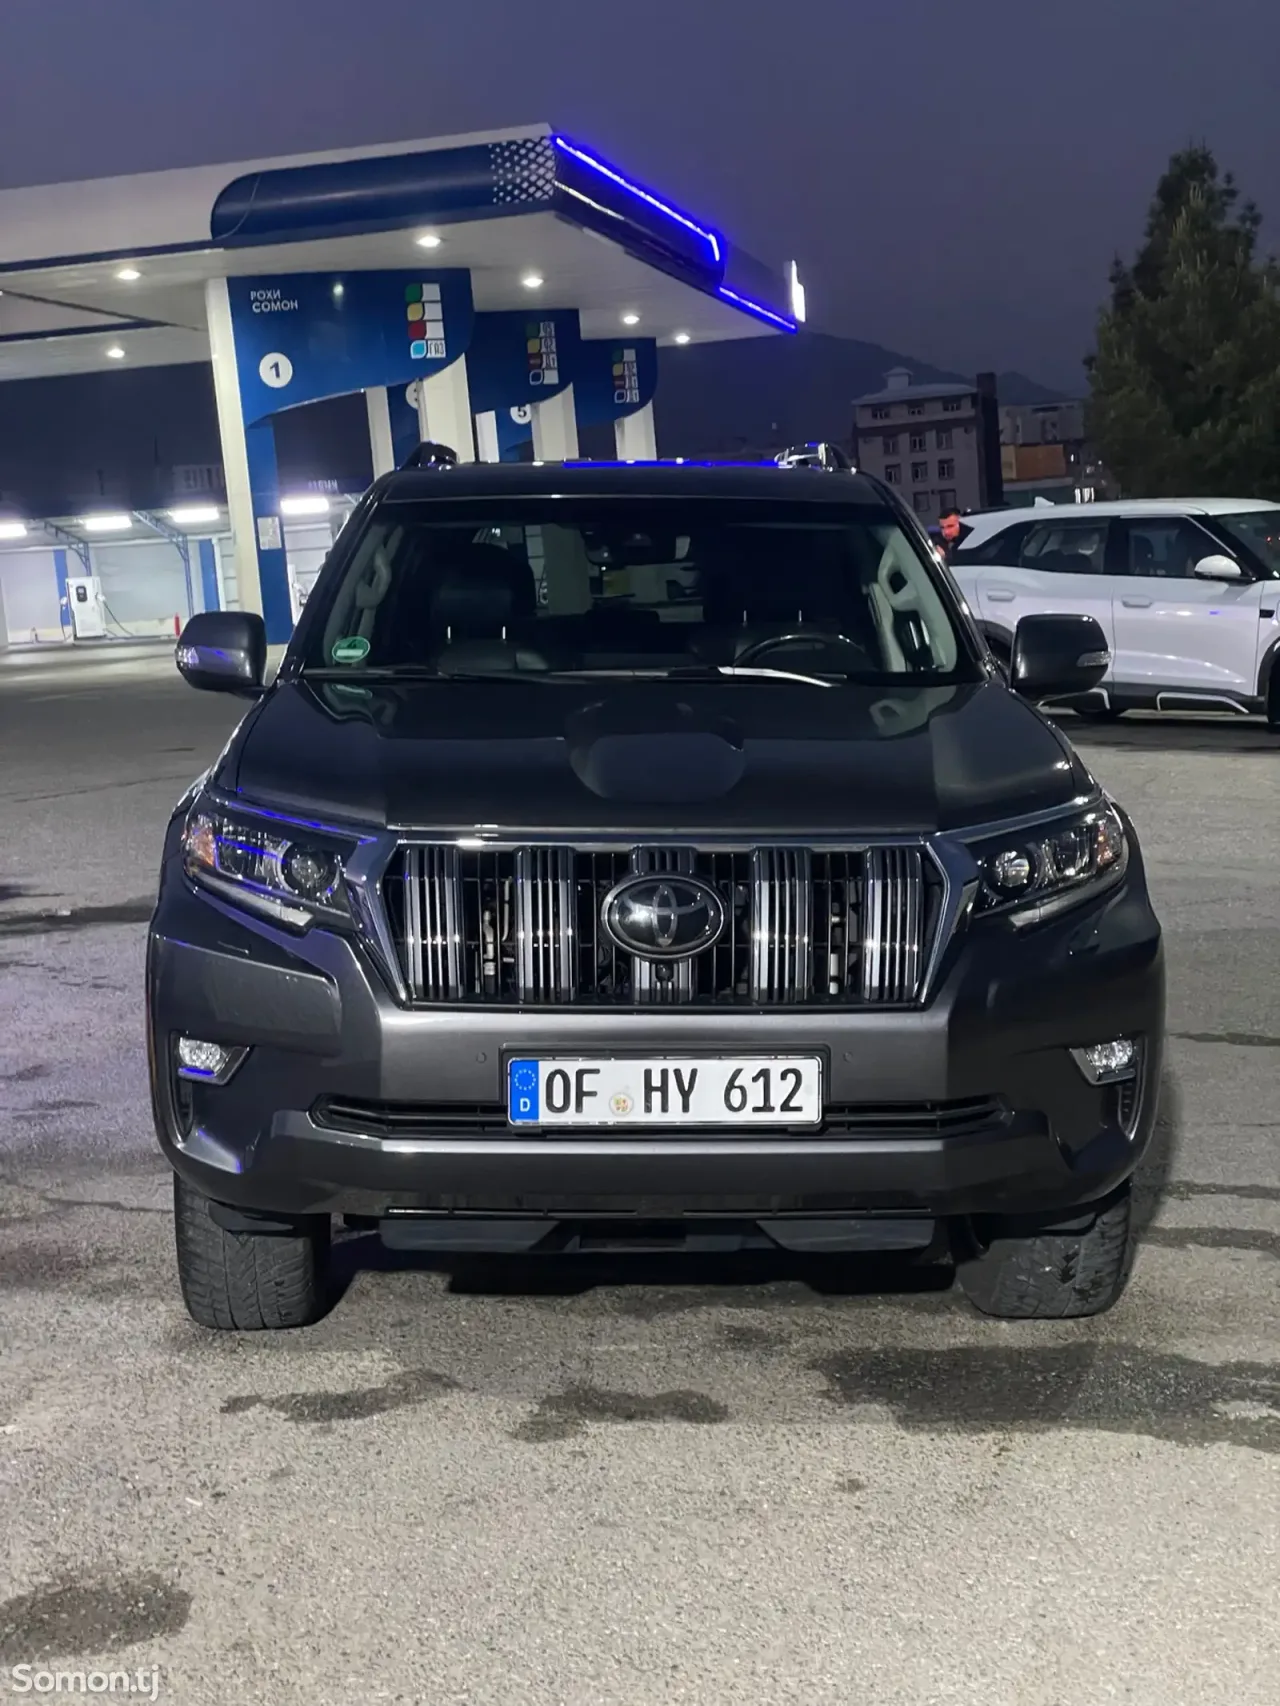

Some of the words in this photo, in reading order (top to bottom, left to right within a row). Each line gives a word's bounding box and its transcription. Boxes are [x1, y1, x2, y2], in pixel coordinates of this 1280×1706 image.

[250, 289, 281, 300] РОХИ
[252, 300, 298, 313] СОМОН
[269, 361, 280, 378] 1
[518, 405, 527, 418] 5
[545, 1068, 600, 1113] OF
[643, 1068, 698, 1113] HY
[723, 1068, 803, 1113] 612
[519, 1098, 530, 1112] D
